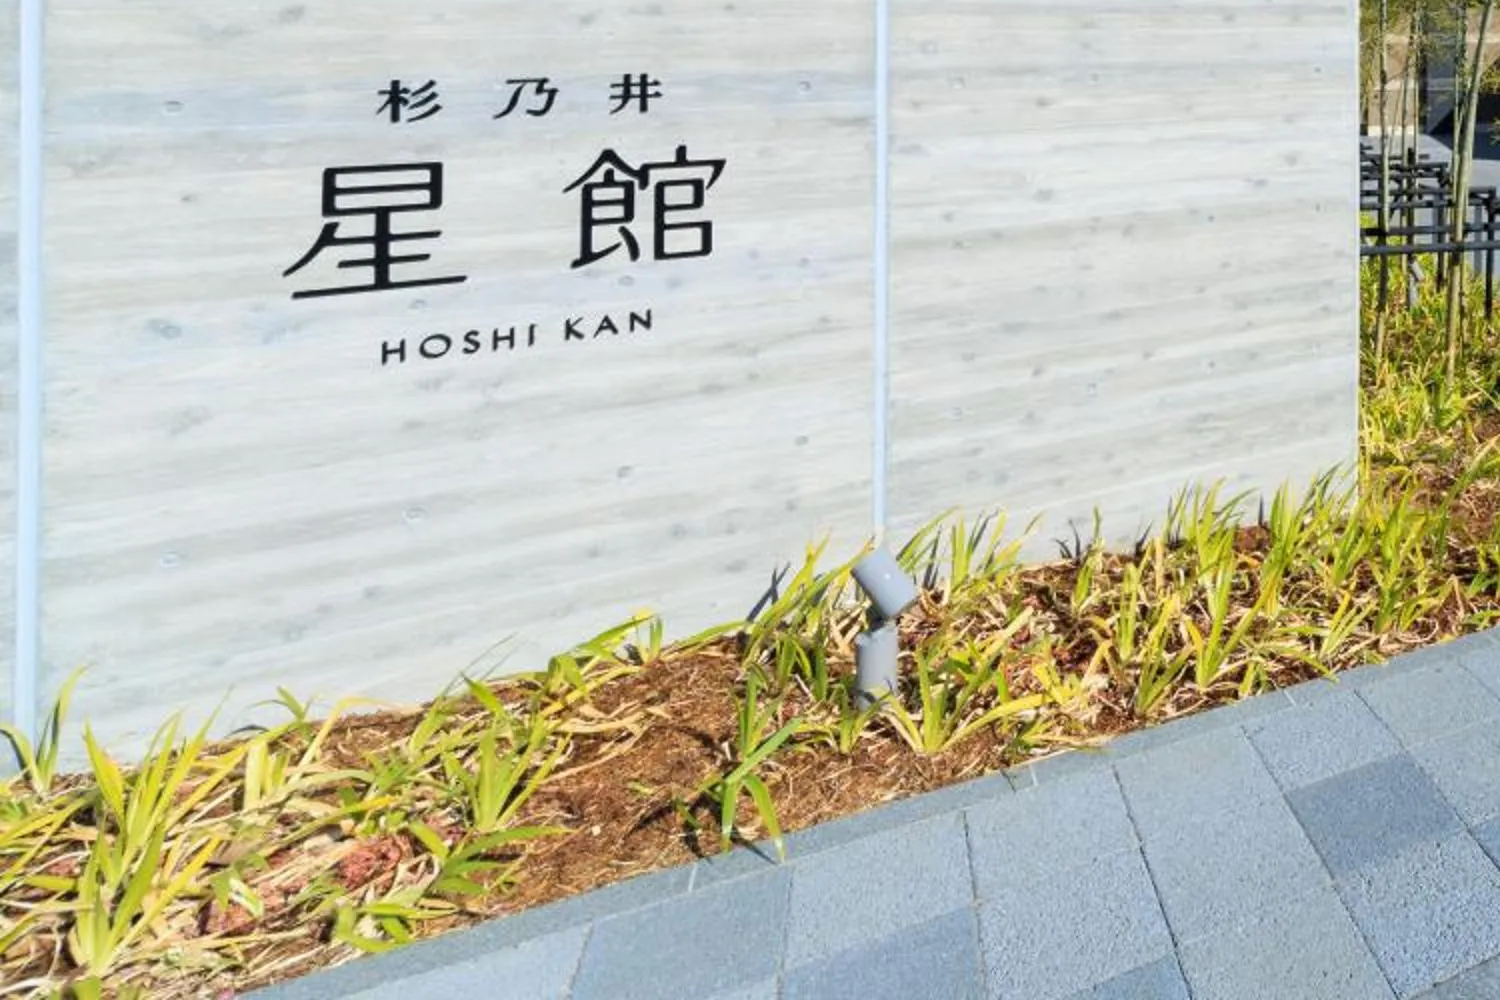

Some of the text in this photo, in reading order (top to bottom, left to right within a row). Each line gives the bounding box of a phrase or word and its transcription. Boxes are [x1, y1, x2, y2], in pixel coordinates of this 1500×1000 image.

[377, 72, 663, 123] 杉乃井
[283, 144, 727, 299] 星館
[380, 309, 653, 365] HOSHI KAN
